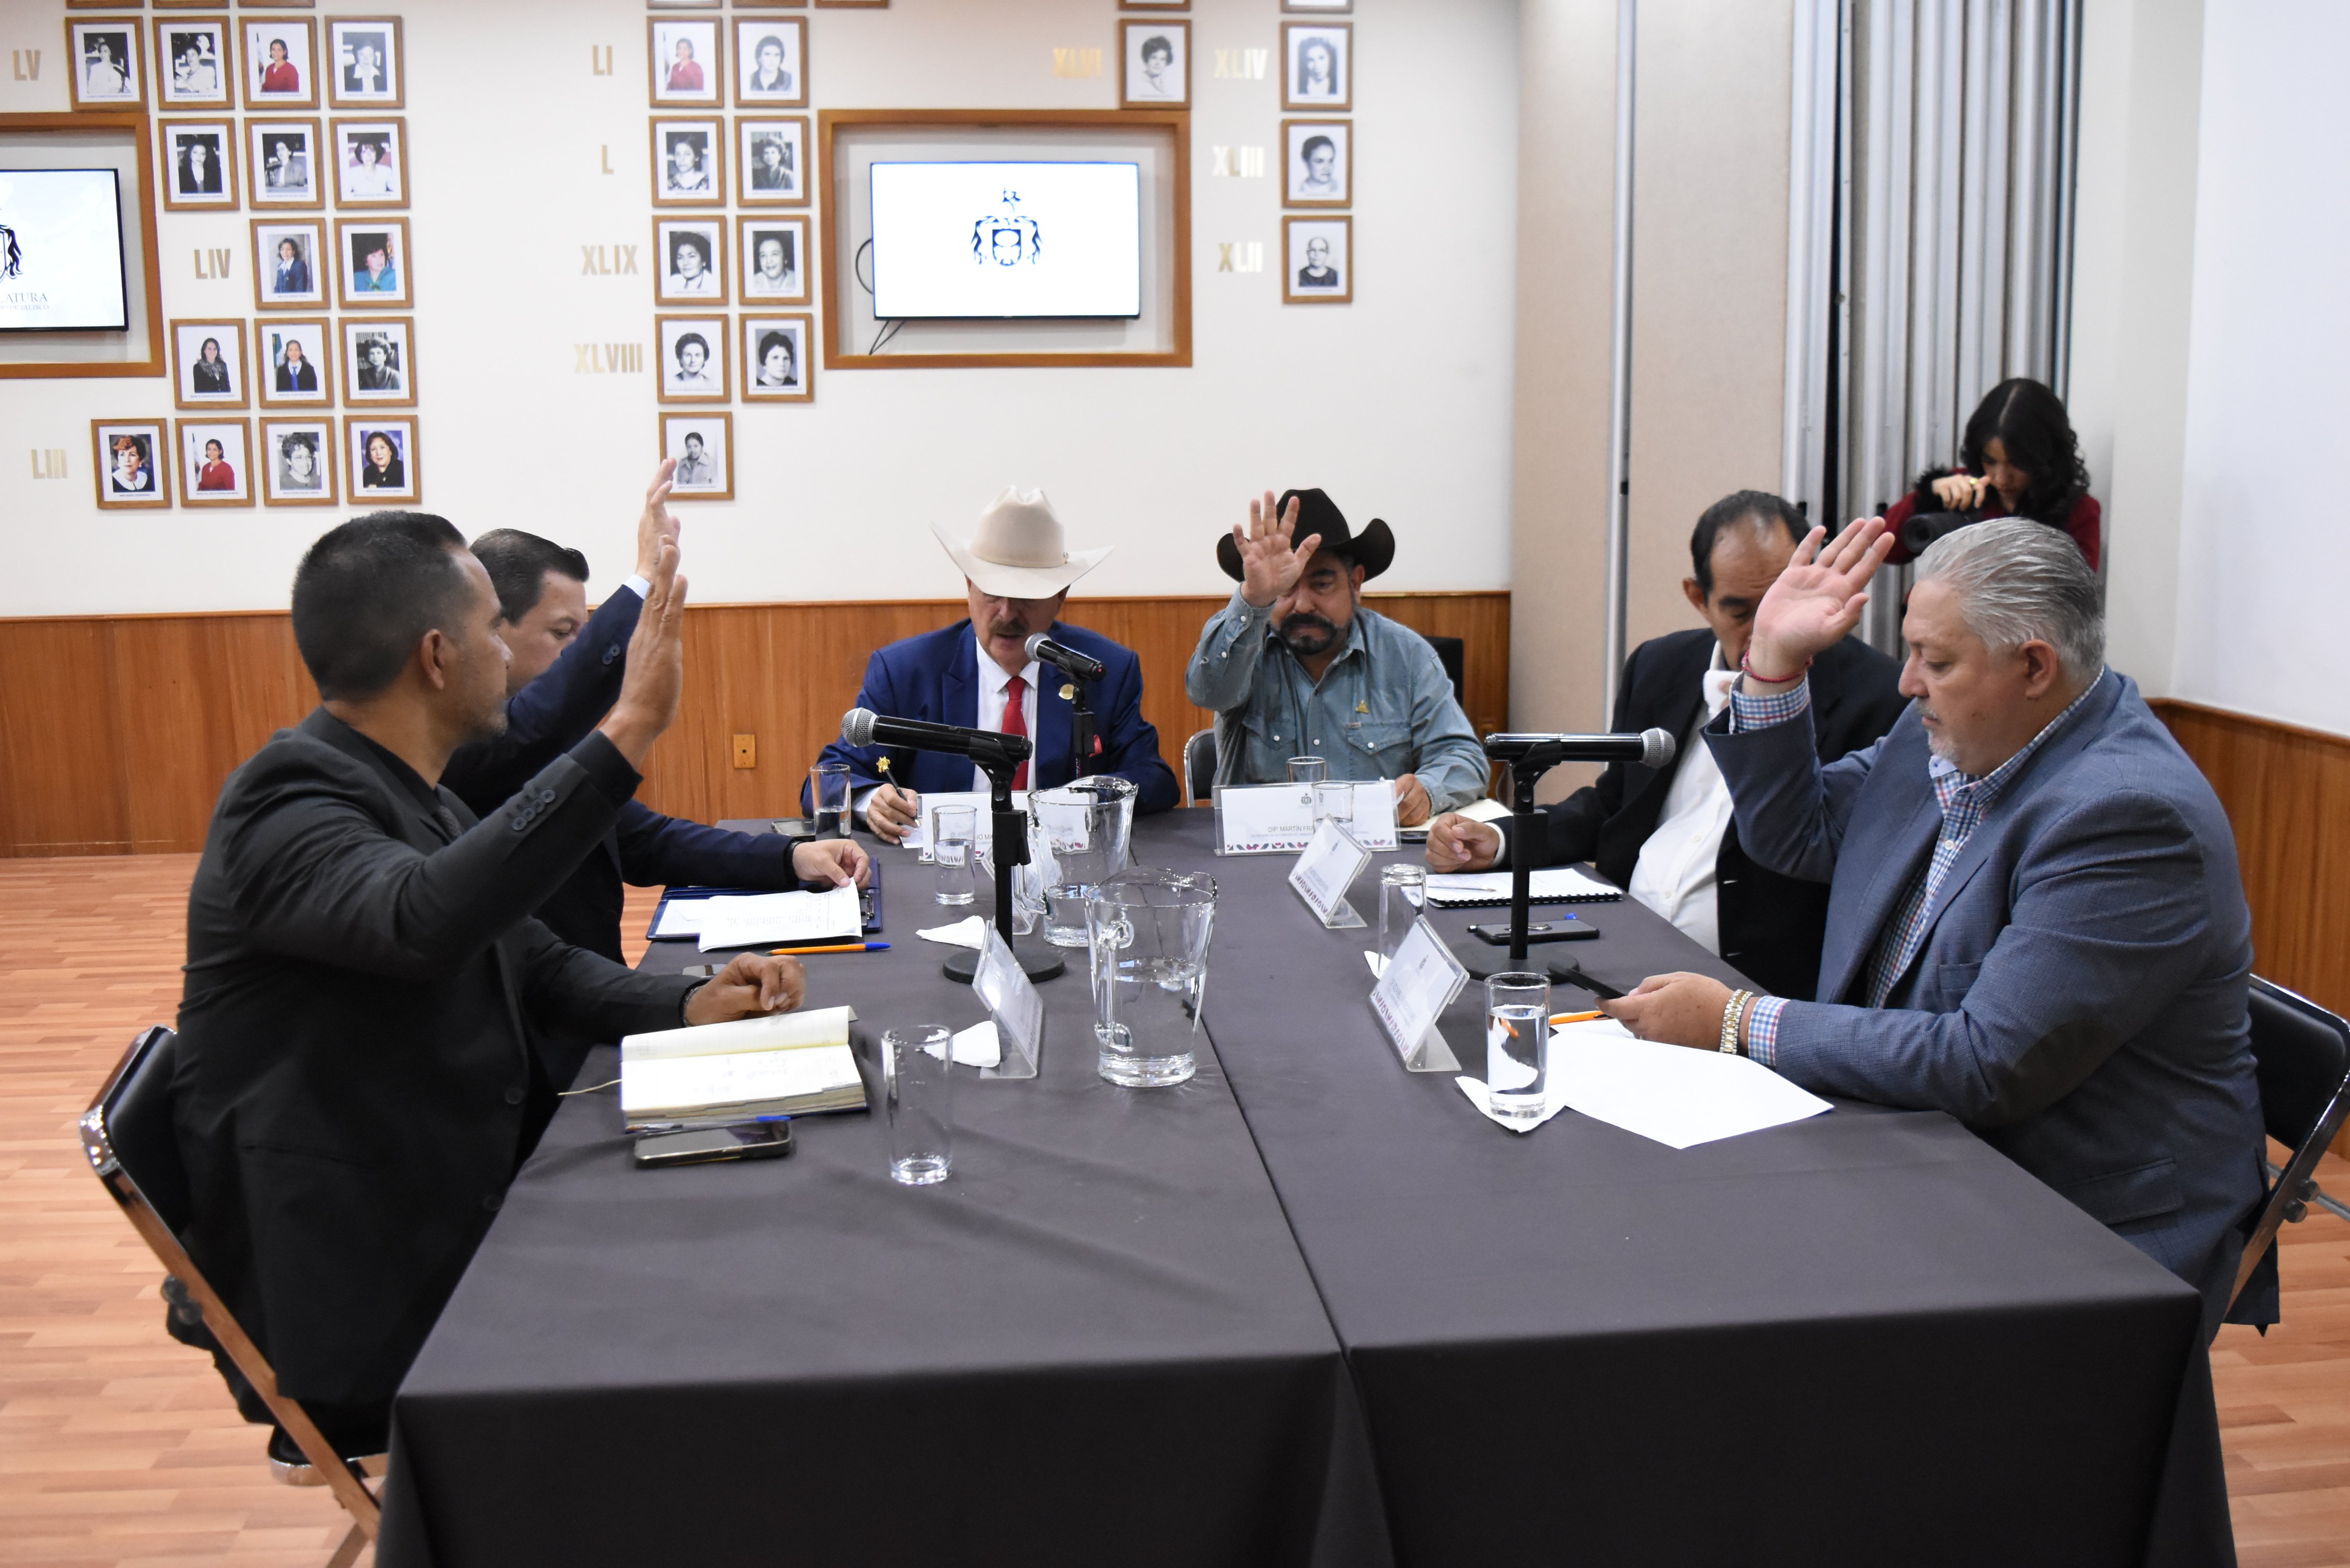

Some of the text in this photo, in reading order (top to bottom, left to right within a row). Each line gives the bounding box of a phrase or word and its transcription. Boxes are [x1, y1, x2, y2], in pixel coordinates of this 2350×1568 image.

[13, 50, 41, 81] LV
[593, 45, 612, 76] LI
[1214, 49, 1268, 80] XLIV
[602, 145, 614, 175] L
[1212, 146, 1265, 178] XLIII
[194, 249, 231, 279] LIV
[581, 245, 639, 275] XLIX
[1218, 242, 1263, 273] XLII
[574, 343, 643, 374] XLVIII
[31, 449, 68, 479] LIII
